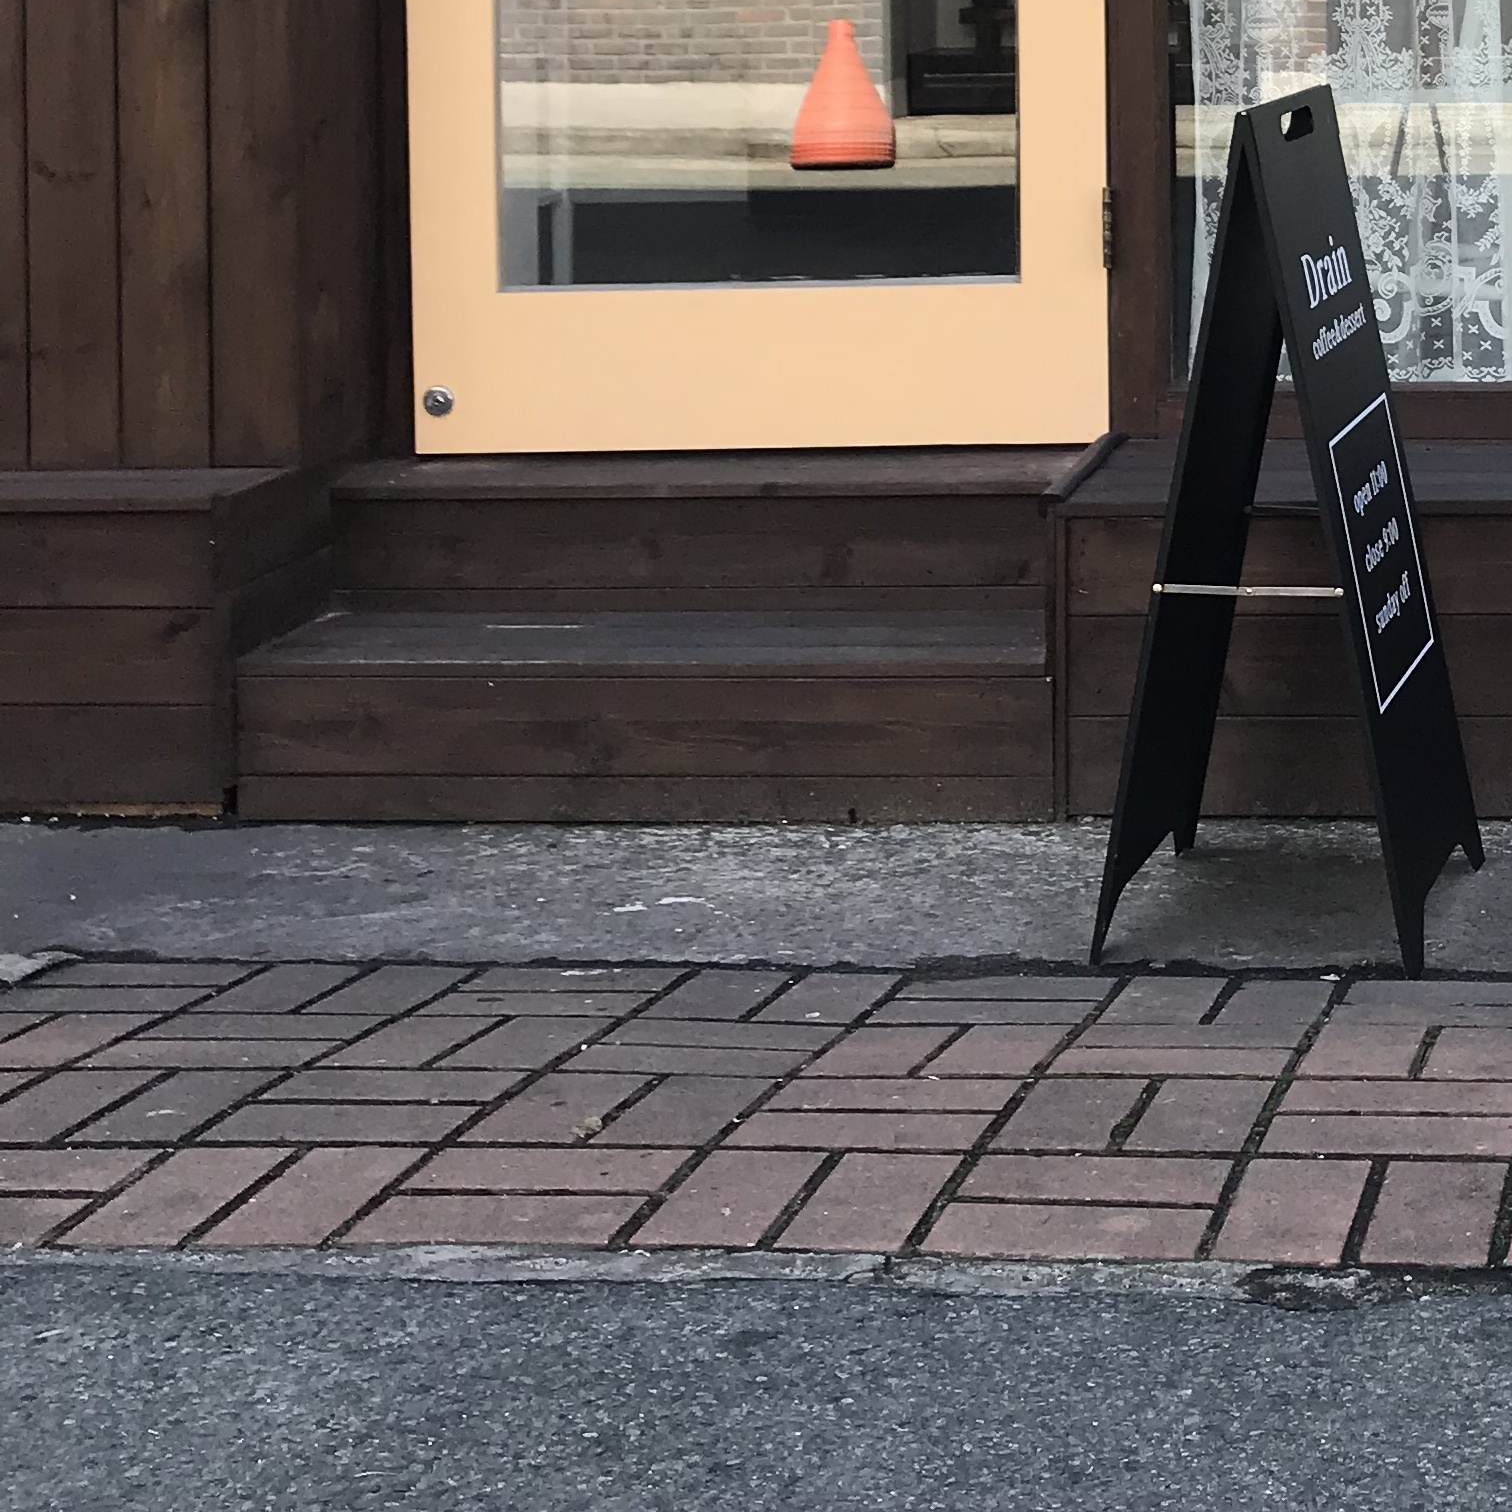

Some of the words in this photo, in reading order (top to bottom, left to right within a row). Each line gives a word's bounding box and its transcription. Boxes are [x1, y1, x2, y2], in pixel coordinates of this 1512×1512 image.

[1301, 236, 1352, 308] Drain
[1354, 483, 1372, 516] open
[1365, 543, 1385, 573] close
[1375, 590, 1401, 634] sunday
[1399, 570, 1411, 604] off
